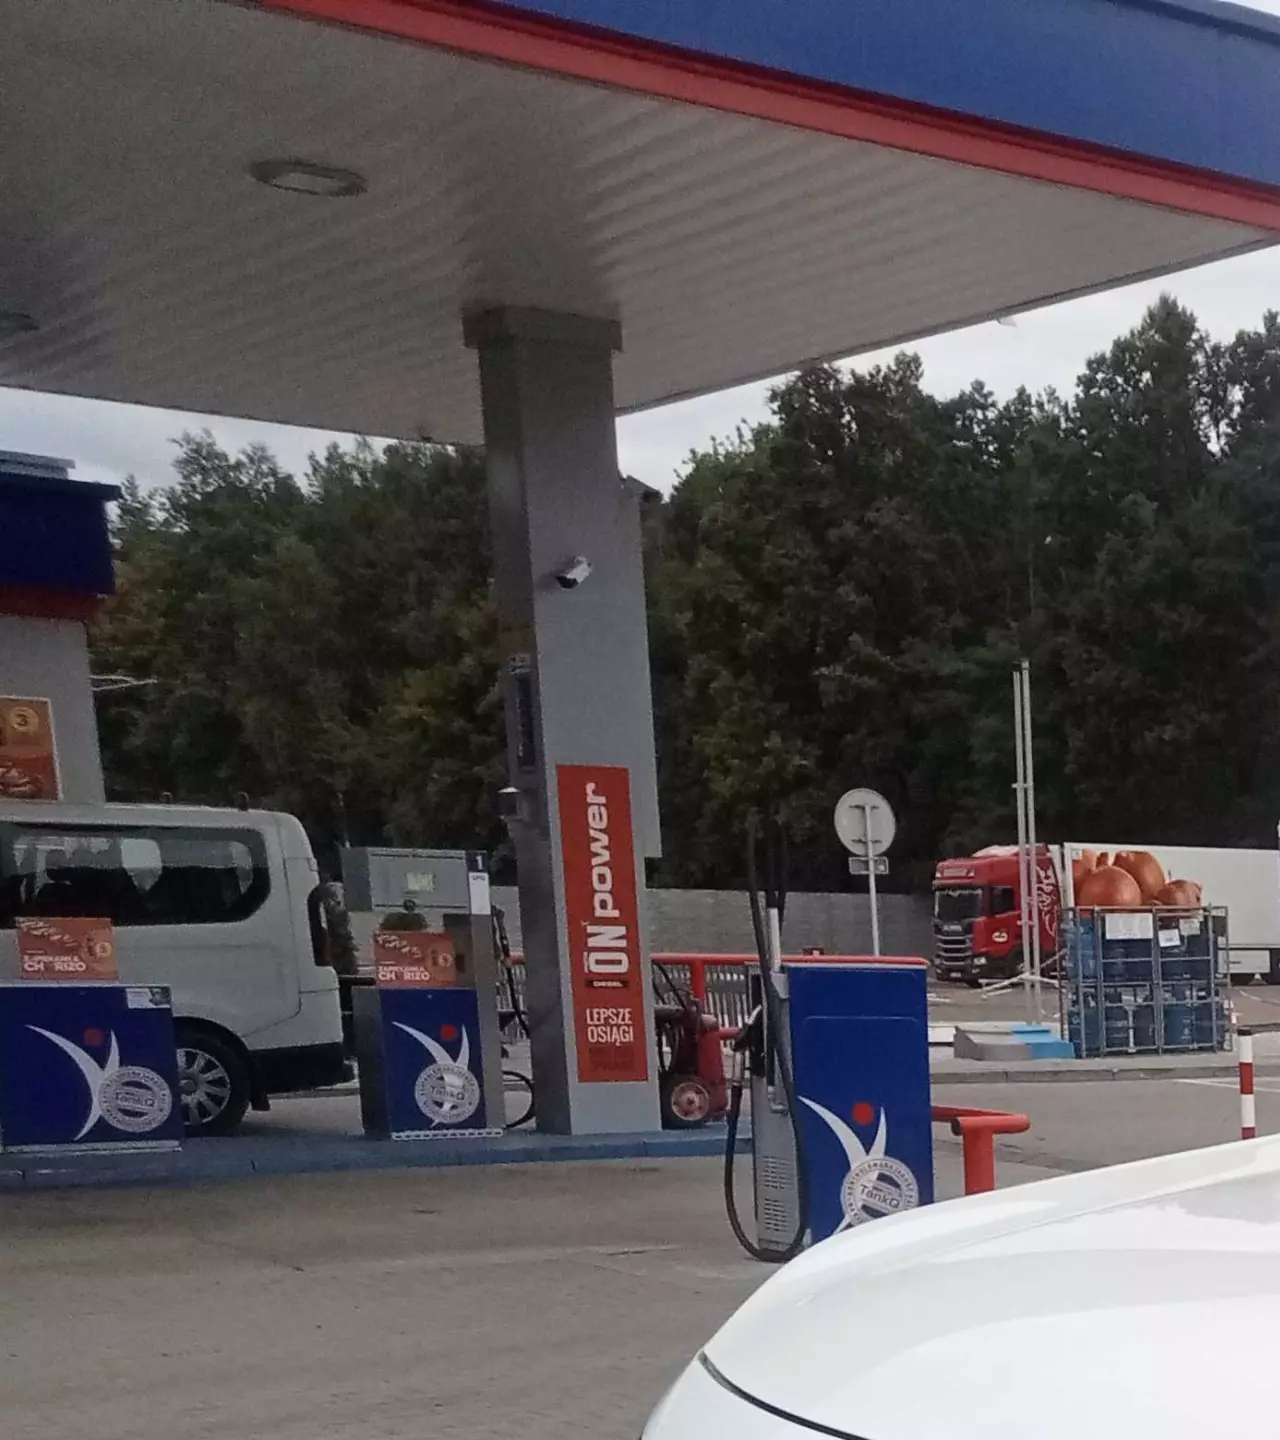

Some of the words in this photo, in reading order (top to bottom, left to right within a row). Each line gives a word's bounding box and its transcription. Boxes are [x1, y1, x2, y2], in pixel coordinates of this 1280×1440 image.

[586, 782, 620, 918] power
[475, 855, 484, 870] 1
[586, 1007, 632, 1025] LEPSZE
[587, 1026, 634, 1047] OSIĄGI
